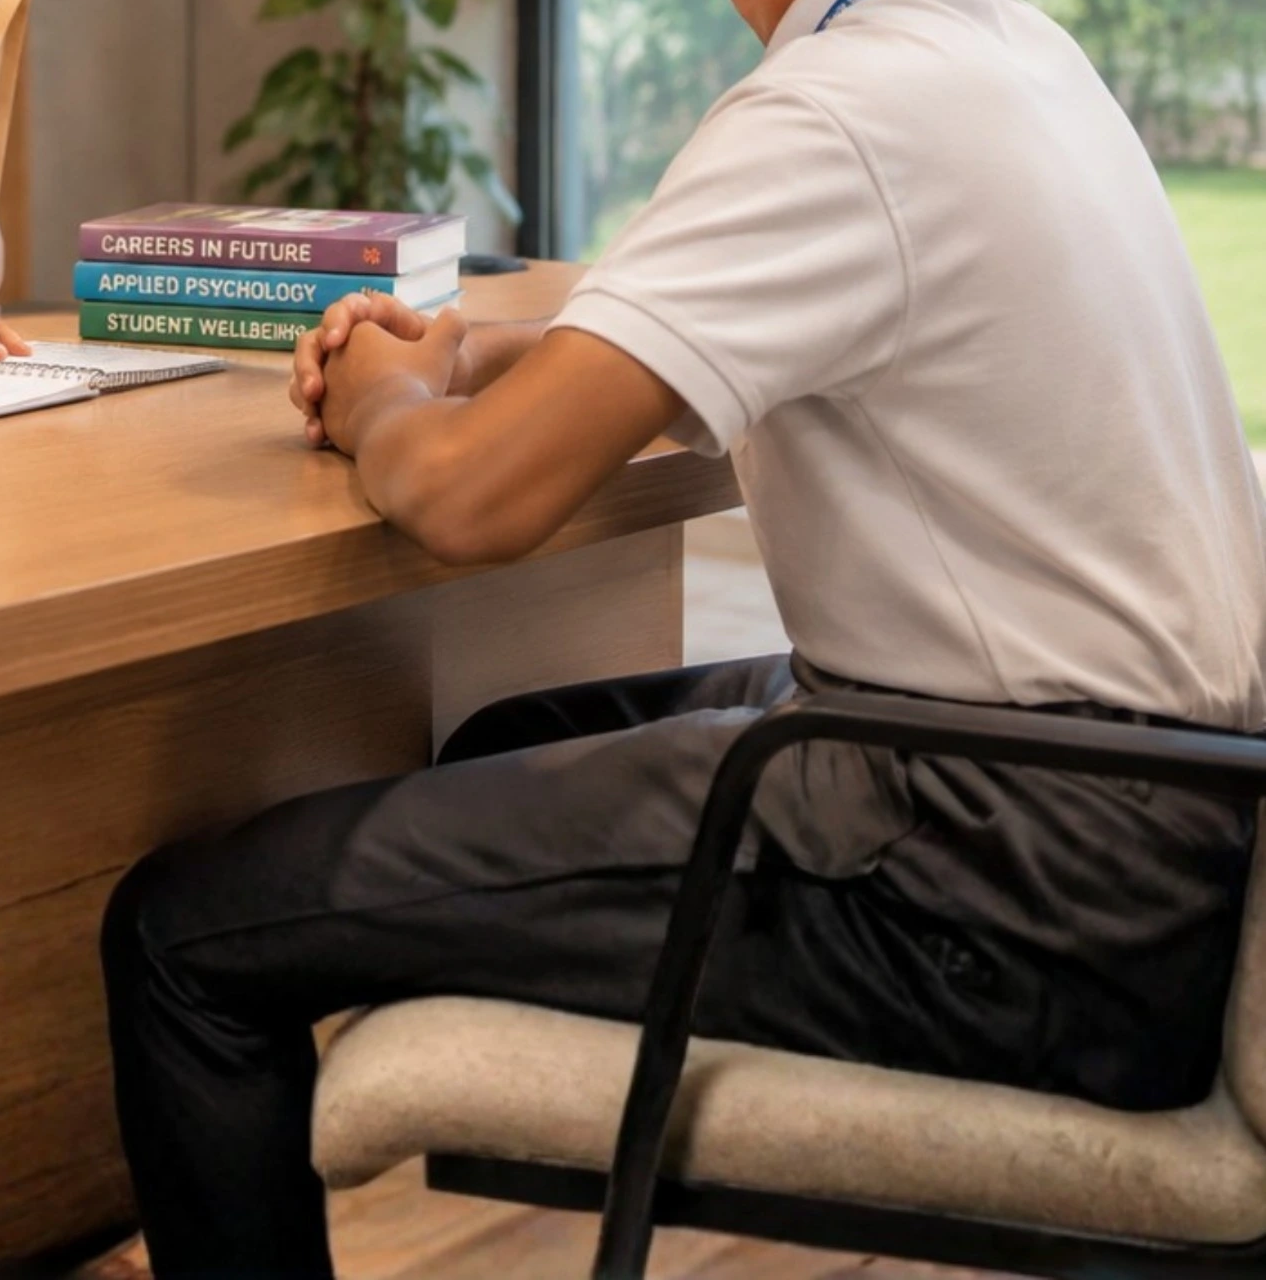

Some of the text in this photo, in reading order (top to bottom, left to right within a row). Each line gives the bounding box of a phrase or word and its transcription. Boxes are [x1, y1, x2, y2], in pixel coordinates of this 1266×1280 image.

[101, 234, 312, 263] CAREERS IN FUTURE
[98, 273, 317, 303] APPLIED PSYCHOLOGY
[107, 313, 193, 336] STUDENT
